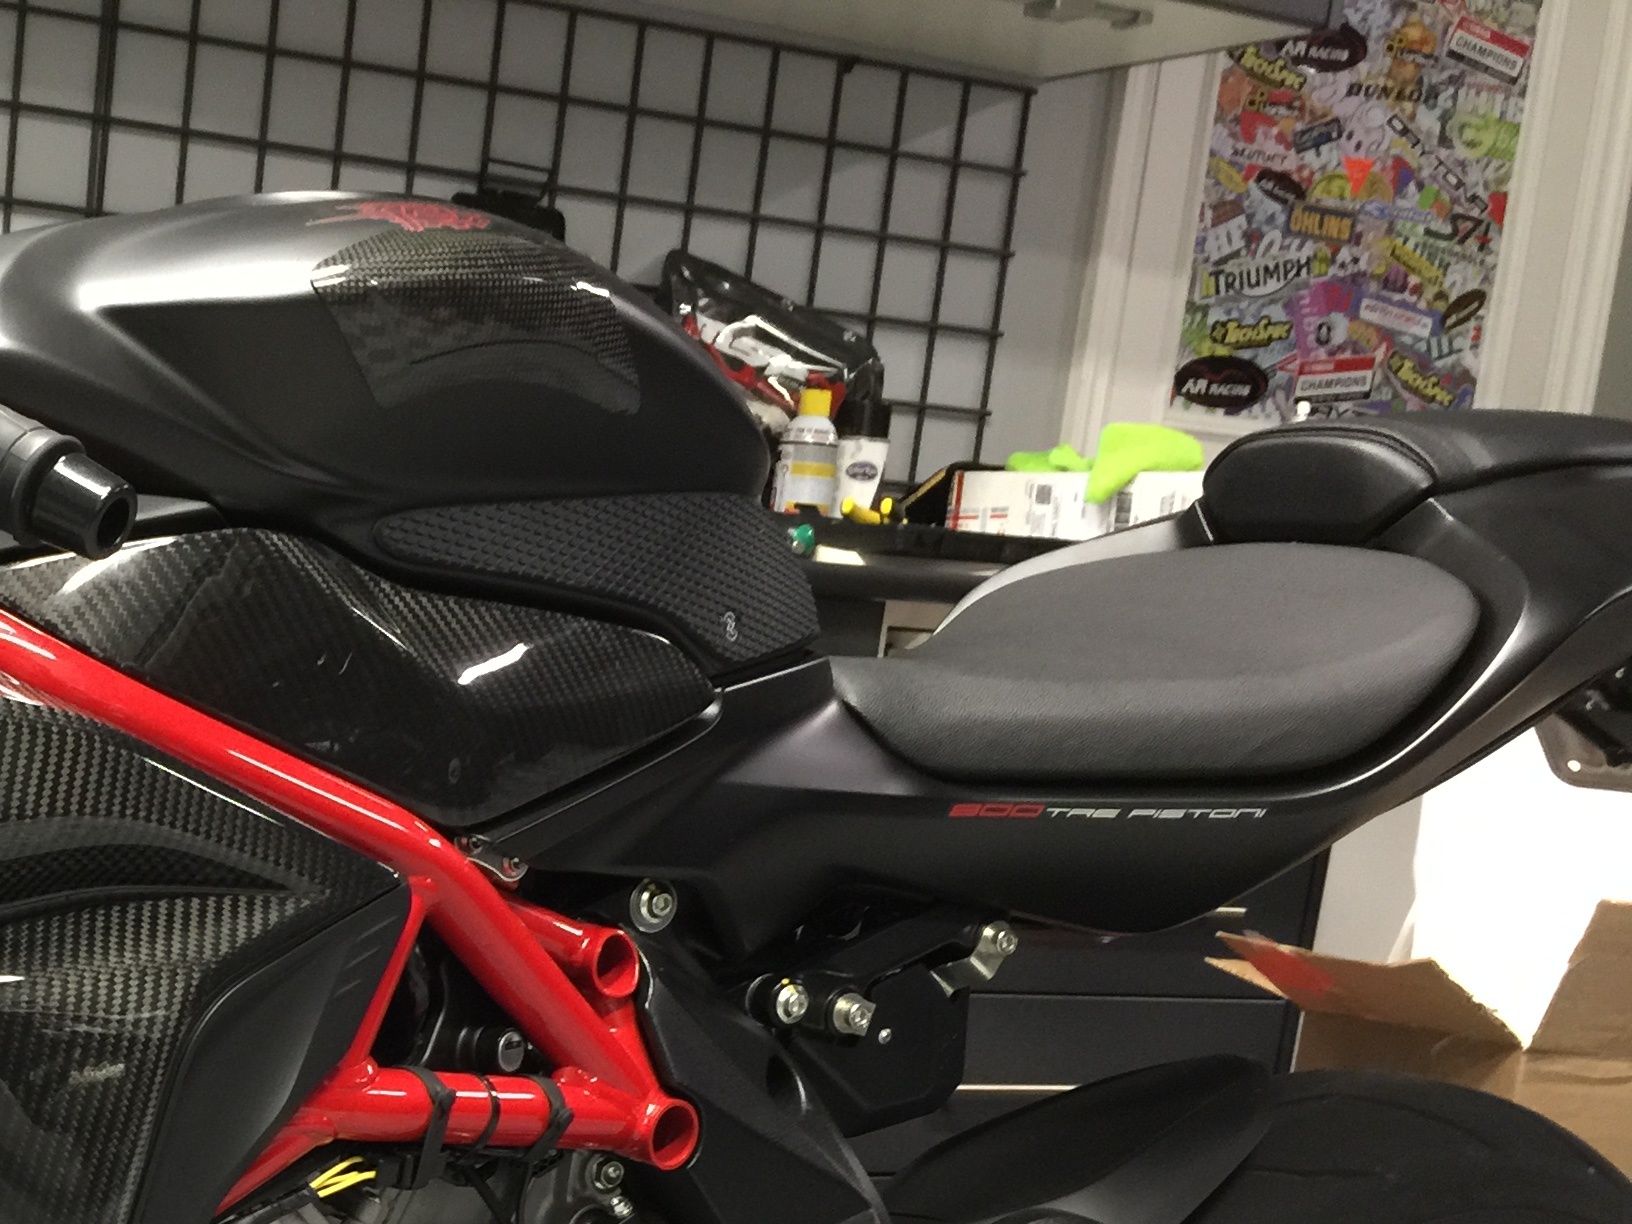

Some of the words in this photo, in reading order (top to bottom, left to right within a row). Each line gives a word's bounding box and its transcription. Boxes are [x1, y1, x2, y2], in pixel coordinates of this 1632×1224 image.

[1456, 36, 1518, 71] CHAMPIONS
[1209, 256, 1311, 296] TRIUMPH
[1300, 375, 1366, 391] CHAMPIONS
[1127, 807, 1268, 820] PISTONI
